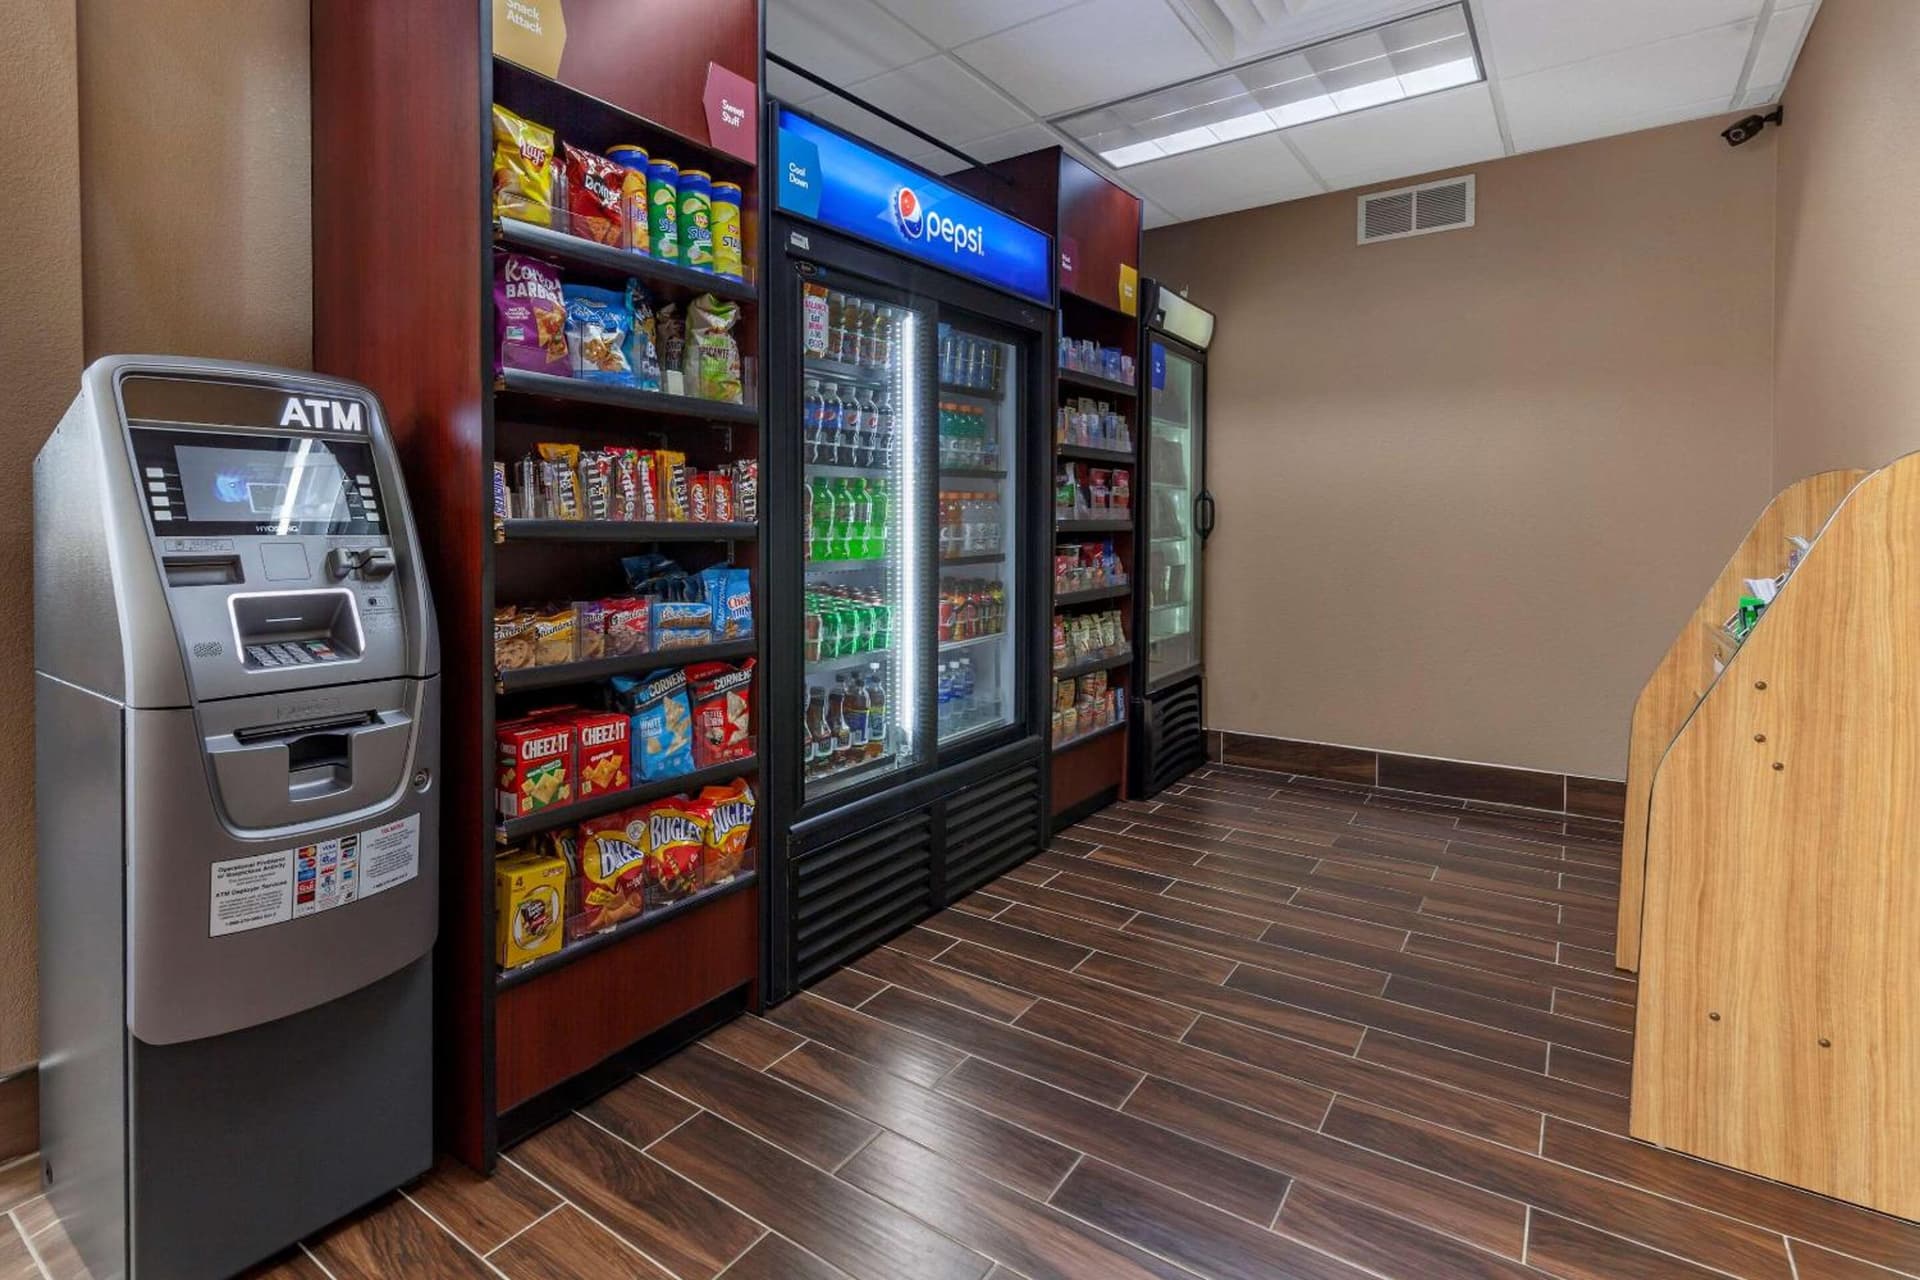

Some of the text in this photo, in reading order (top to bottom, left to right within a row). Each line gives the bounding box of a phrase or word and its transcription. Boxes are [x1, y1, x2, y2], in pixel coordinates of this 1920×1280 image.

[506, 0, 540, 20] Snack
[506, 9, 542, 35] Attack
[721, 98, 745, 119] Sweet
[721, 110, 741, 127] Stuff
[789, 162, 806, 176] Cool
[789, 173, 809, 190] Down
[926, 211, 984, 256] pepsi
[279, 397, 362, 431] ATM
[650, 814, 704, 850] BUGLES
